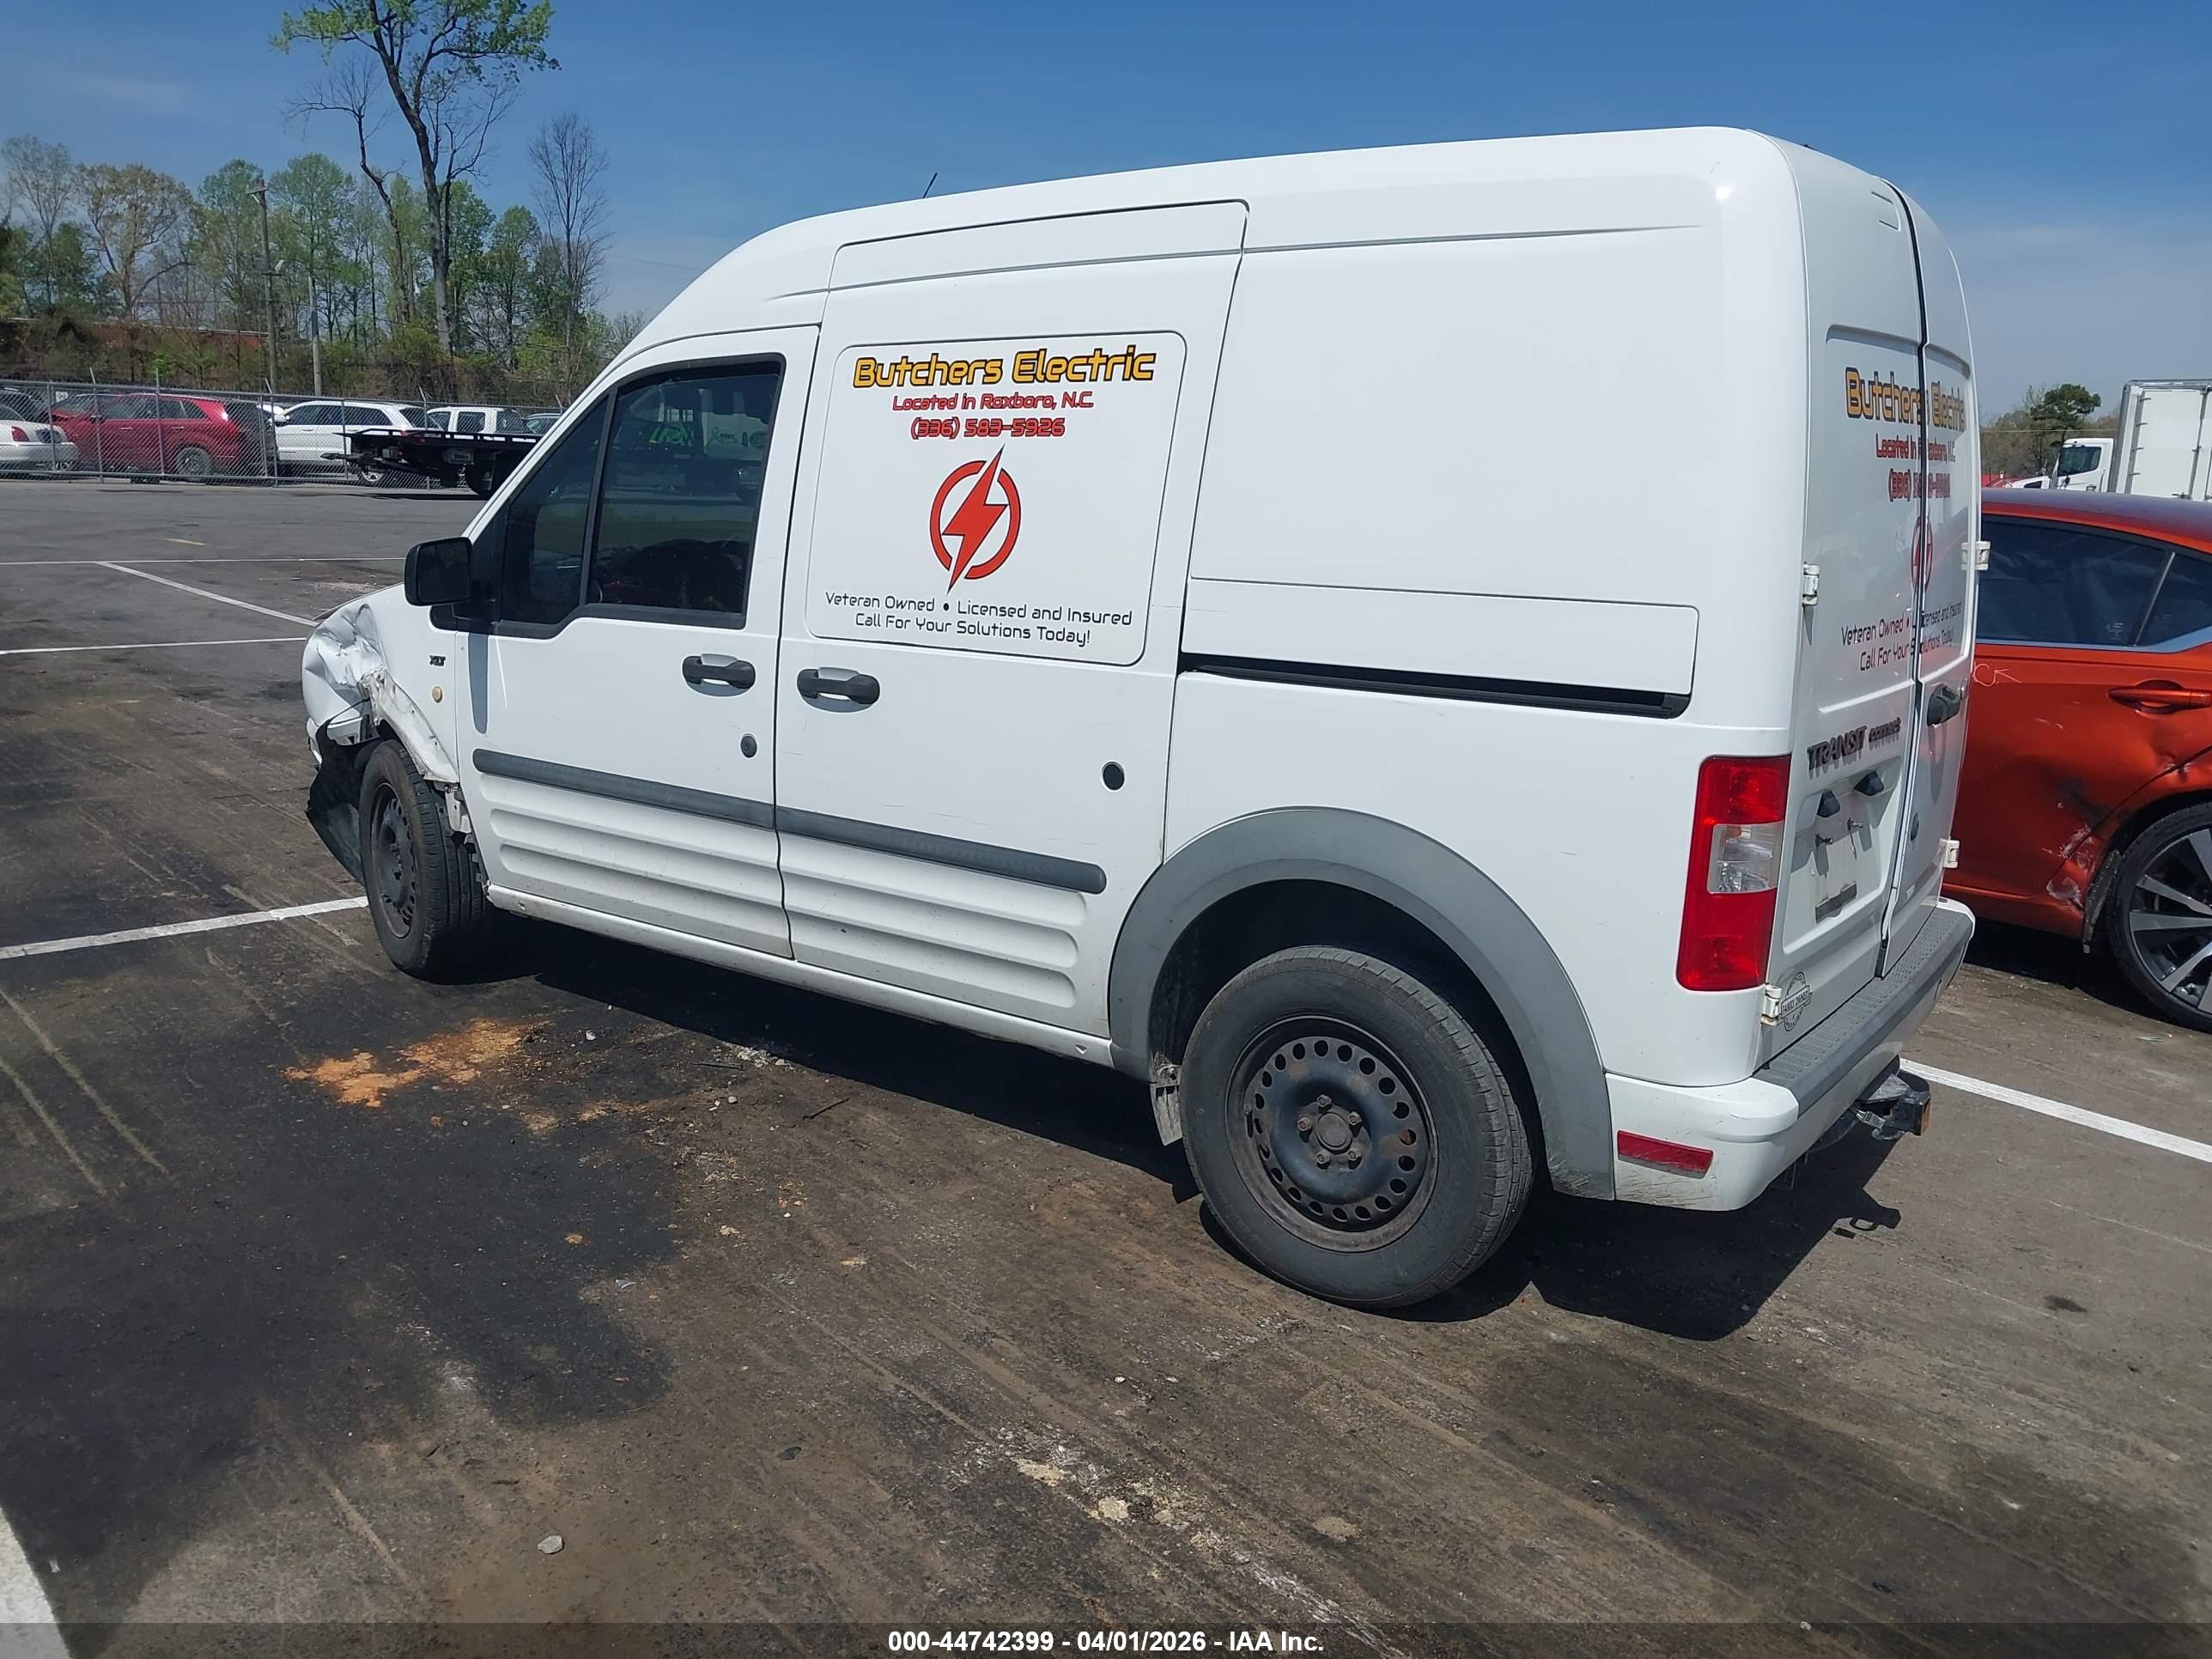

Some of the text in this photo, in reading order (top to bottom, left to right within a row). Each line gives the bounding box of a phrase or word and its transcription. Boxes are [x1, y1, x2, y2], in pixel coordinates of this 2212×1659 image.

[853, 345, 1156, 388] Butchers Electric
[892, 391, 1094, 410] Located in Roxboro, N.C.
[910, 416, 1065, 439] (336) 583-5926
[1876, 434, 1909, 459] Located
[825, 592, 1133, 626] Veteran Owned Licensed and Insured
[855, 613, 1091, 647] Call For Your Solutions Today!
[1842, 624, 1876, 646] Veteran
[1879, 613, 1905, 638] Owned
[1860, 650, 1875, 672] Call
[1878, 647, 1891, 666] For
[1893, 642, 1909, 661] Your
